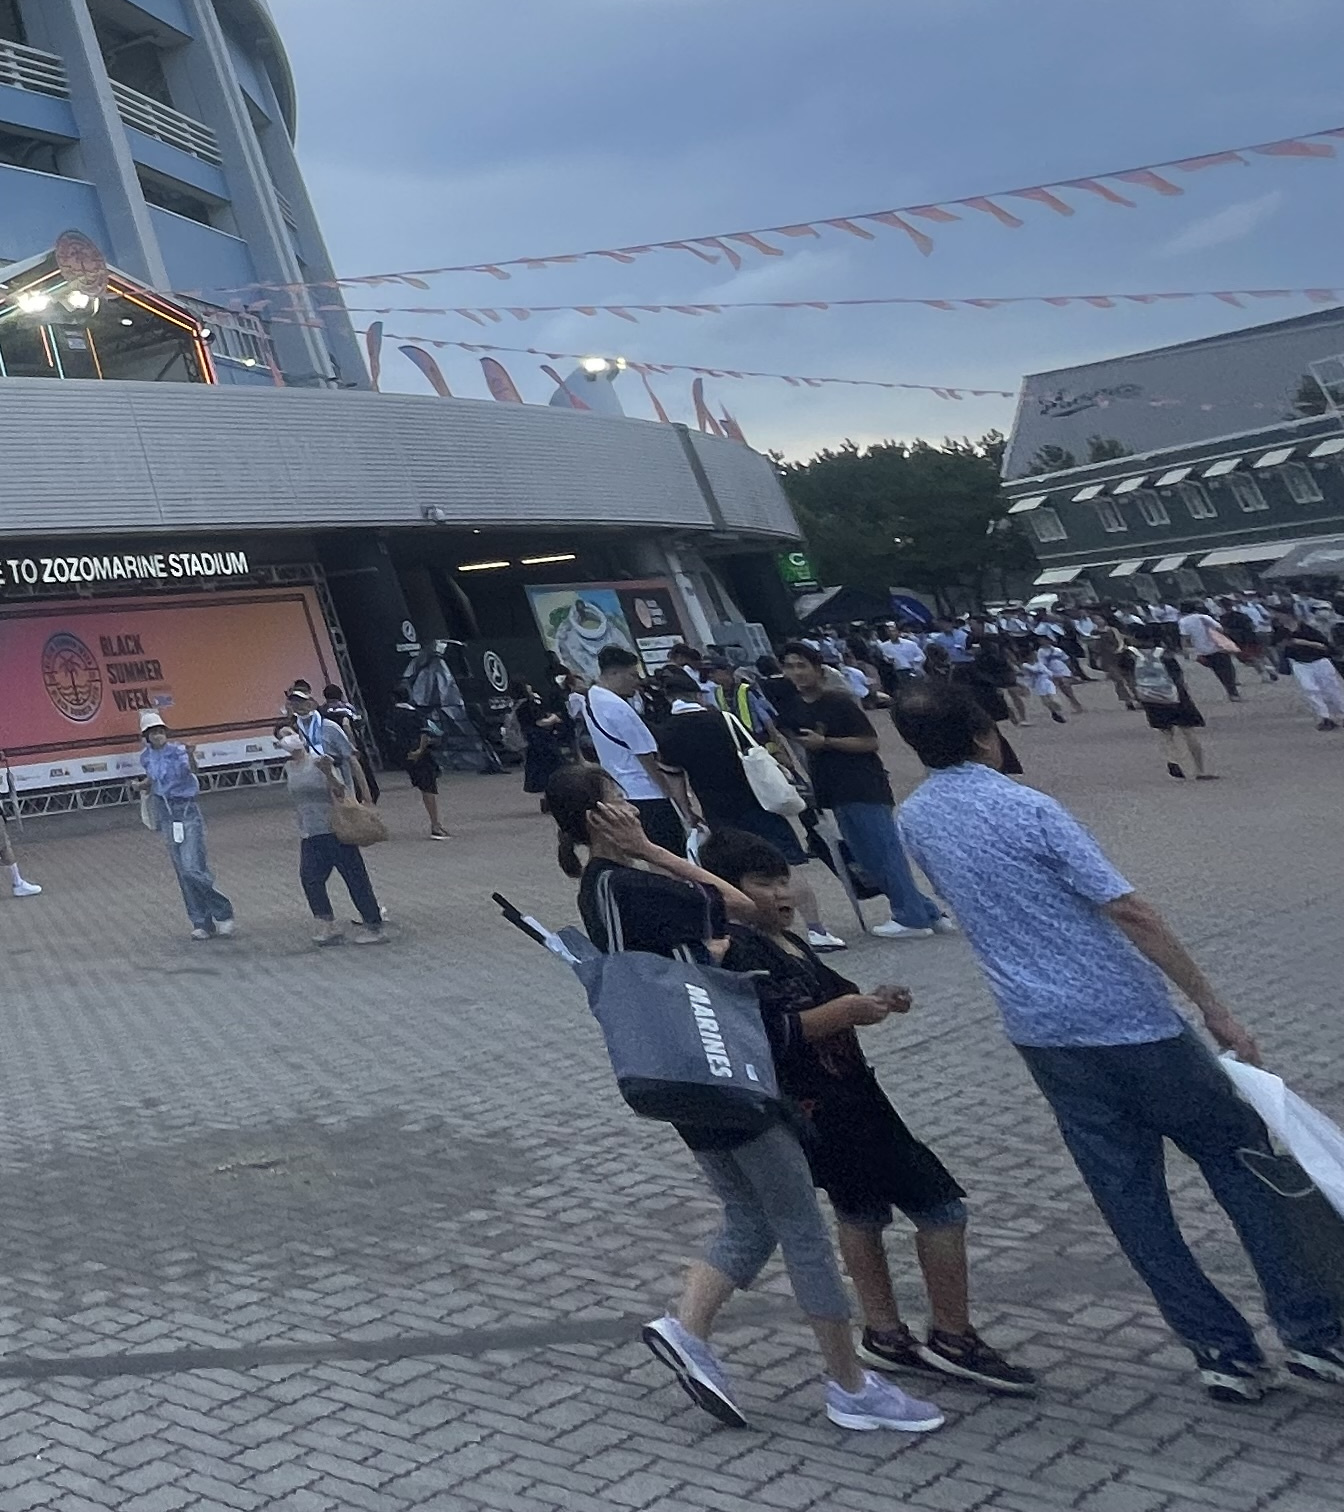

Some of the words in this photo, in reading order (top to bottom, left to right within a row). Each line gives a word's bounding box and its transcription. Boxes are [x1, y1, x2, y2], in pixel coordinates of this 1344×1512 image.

[9, 559, 39, 585] TO
[40, 554, 169, 583] ZOZOMARINE
[168, 551, 250, 577] STADIUM
[99, 634, 145, 657] BLACK
[106, 659, 164, 684] SUMMER
[112, 688, 153, 712] WEEK
[684, 982, 733, 1078] MARINES
